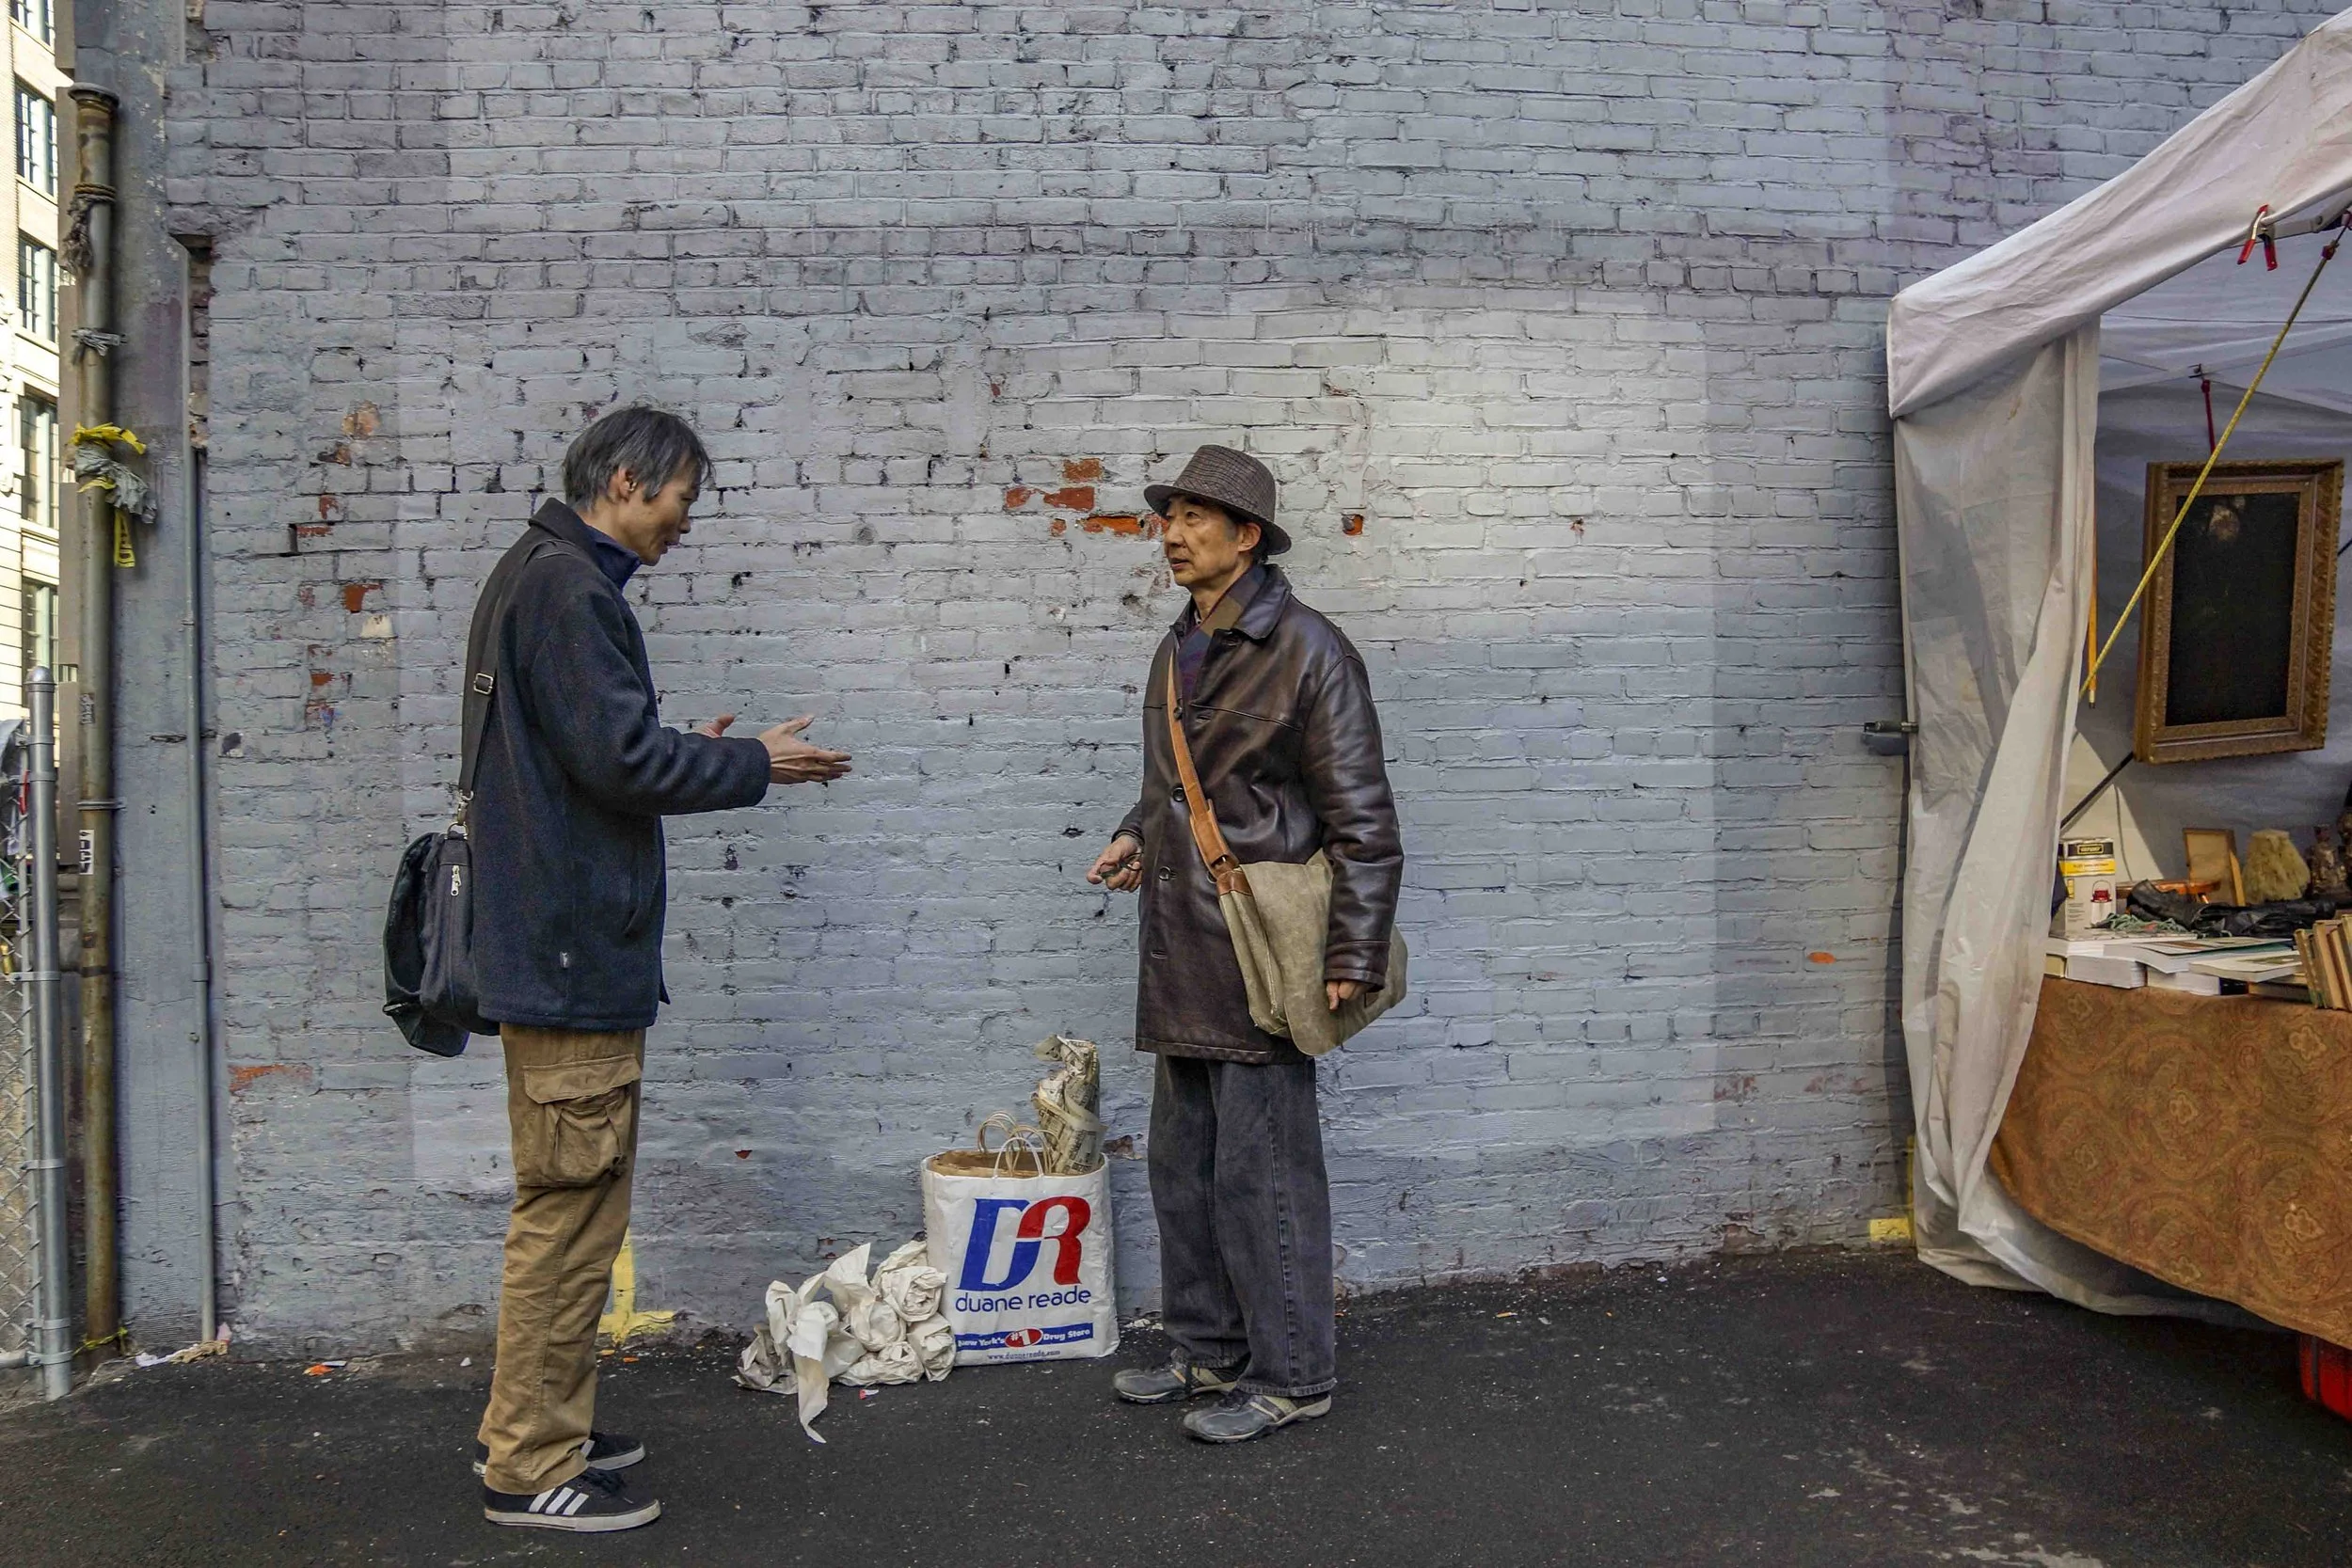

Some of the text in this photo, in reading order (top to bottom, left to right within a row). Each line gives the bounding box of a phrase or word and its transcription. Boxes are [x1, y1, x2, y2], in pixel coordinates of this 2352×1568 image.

[955, 1285, 1091, 1313] duane reade
[958, 1328, 1090, 1348] New York's #1 Drug Store
